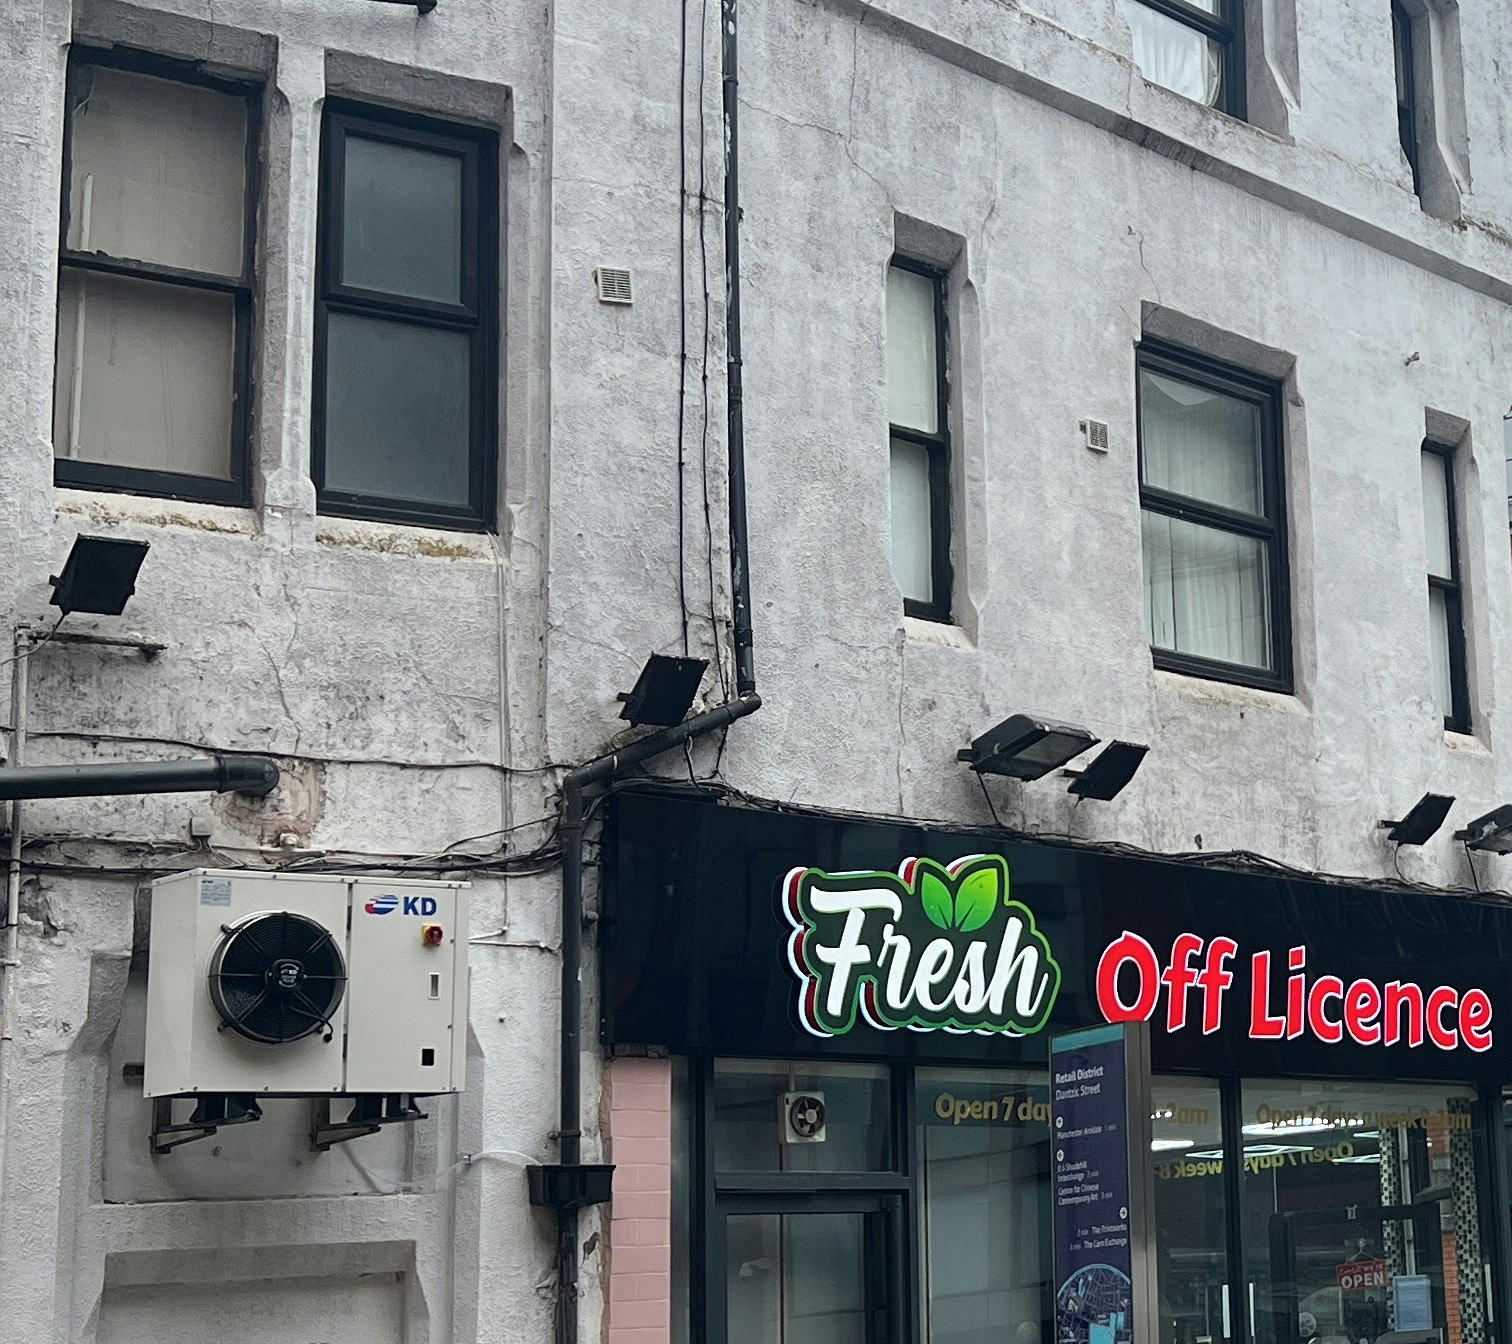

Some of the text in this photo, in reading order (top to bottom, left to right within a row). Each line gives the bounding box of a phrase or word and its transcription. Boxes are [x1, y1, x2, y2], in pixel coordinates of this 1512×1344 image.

[403, 895, 437, 916] KD
[809, 885, 1050, 1018] Fresh
[1096, 930, 1238, 1035] Off
[1249, 945, 1494, 1053] Licence
[1055, 1065, 1103, 1084] Retail District
[1080, 1083, 1101, 1096] Street
[935, 1091, 998, 1125] Open
[1002, 1096, 1015, 1122] 7
[1341, 1271, 1384, 1289] OPEN
